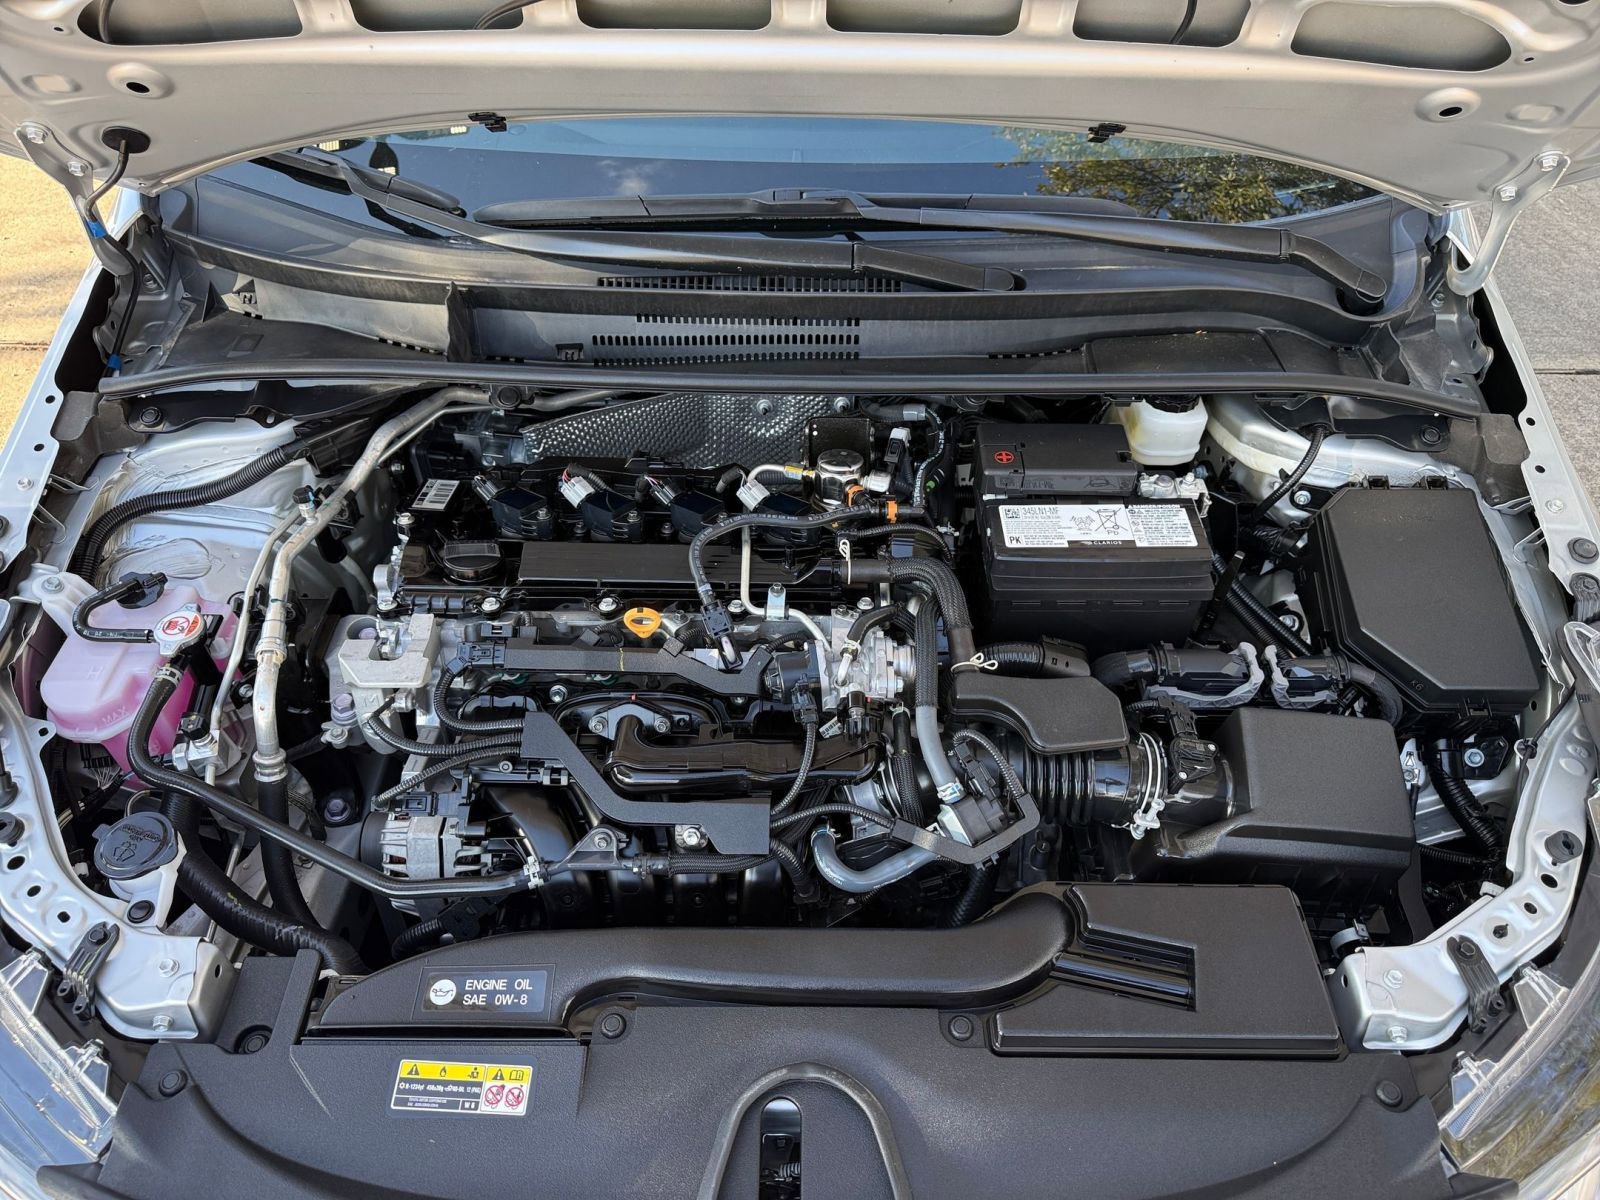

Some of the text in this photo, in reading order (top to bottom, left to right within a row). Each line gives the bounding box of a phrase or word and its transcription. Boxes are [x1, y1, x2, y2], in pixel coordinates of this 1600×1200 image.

[1009, 536, 1022, 545] PK
[101, 705, 130, 725] MAX
[464, 978, 533, 990] ENGINE OIL
[462, 994, 528, 1006] SAE 0W-8
